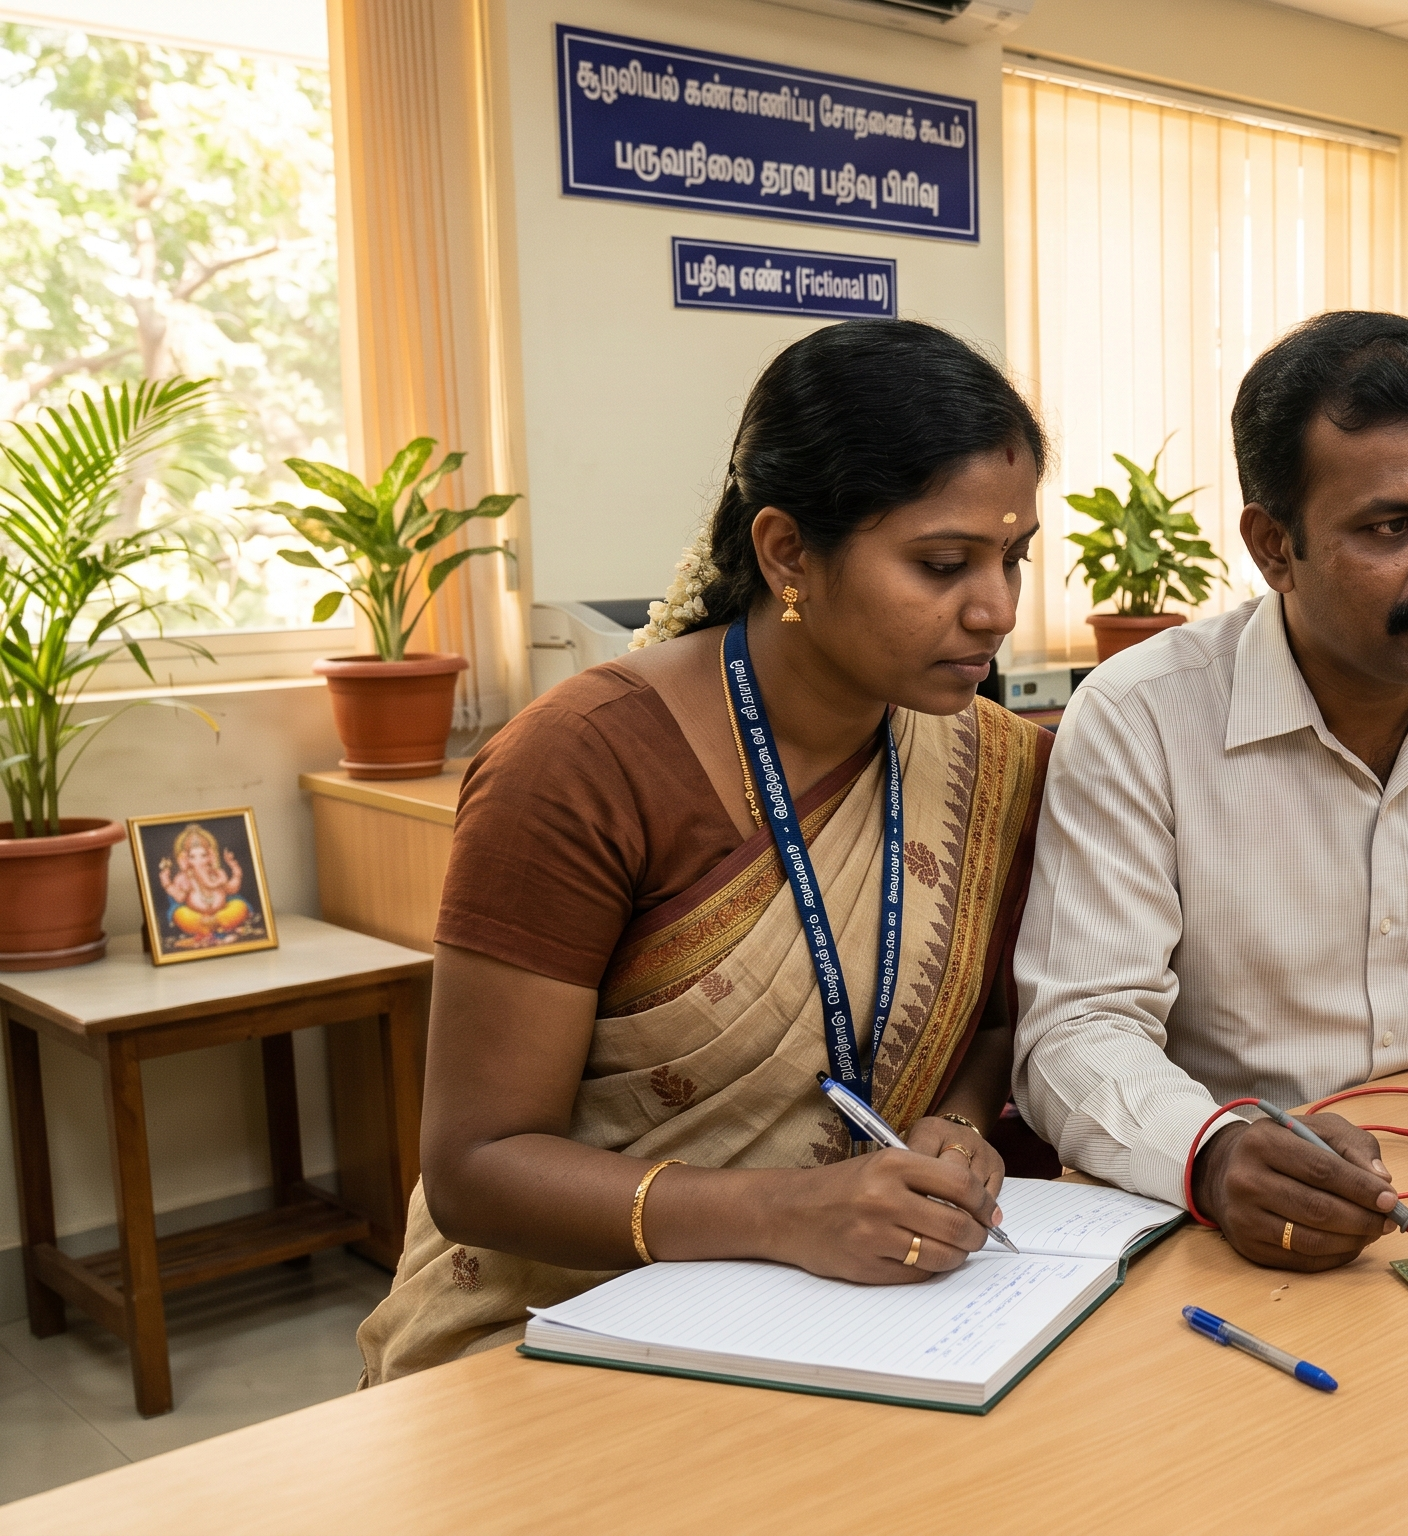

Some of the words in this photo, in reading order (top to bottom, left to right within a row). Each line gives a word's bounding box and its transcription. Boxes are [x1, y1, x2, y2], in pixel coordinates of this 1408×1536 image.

[576, 59, 680, 104] சூழலியல்
[684, 73, 815, 132] கண்காணிப்பு
[819, 94, 917, 140] சோதனைக்
[919, 115, 966, 148] கூடம்
[615, 140, 755, 188] பருவநிலை
[760, 160, 815, 201] தரவு
[821, 163, 878, 210] பதிவு
[882, 169, 939, 217] பிரிவு
[685, 254, 736, 297] பதிவு
[739, 259, 791, 294] எண்:
[795, 266, 865, 304] (Fictional
[867, 273, 889, 310] ID)
